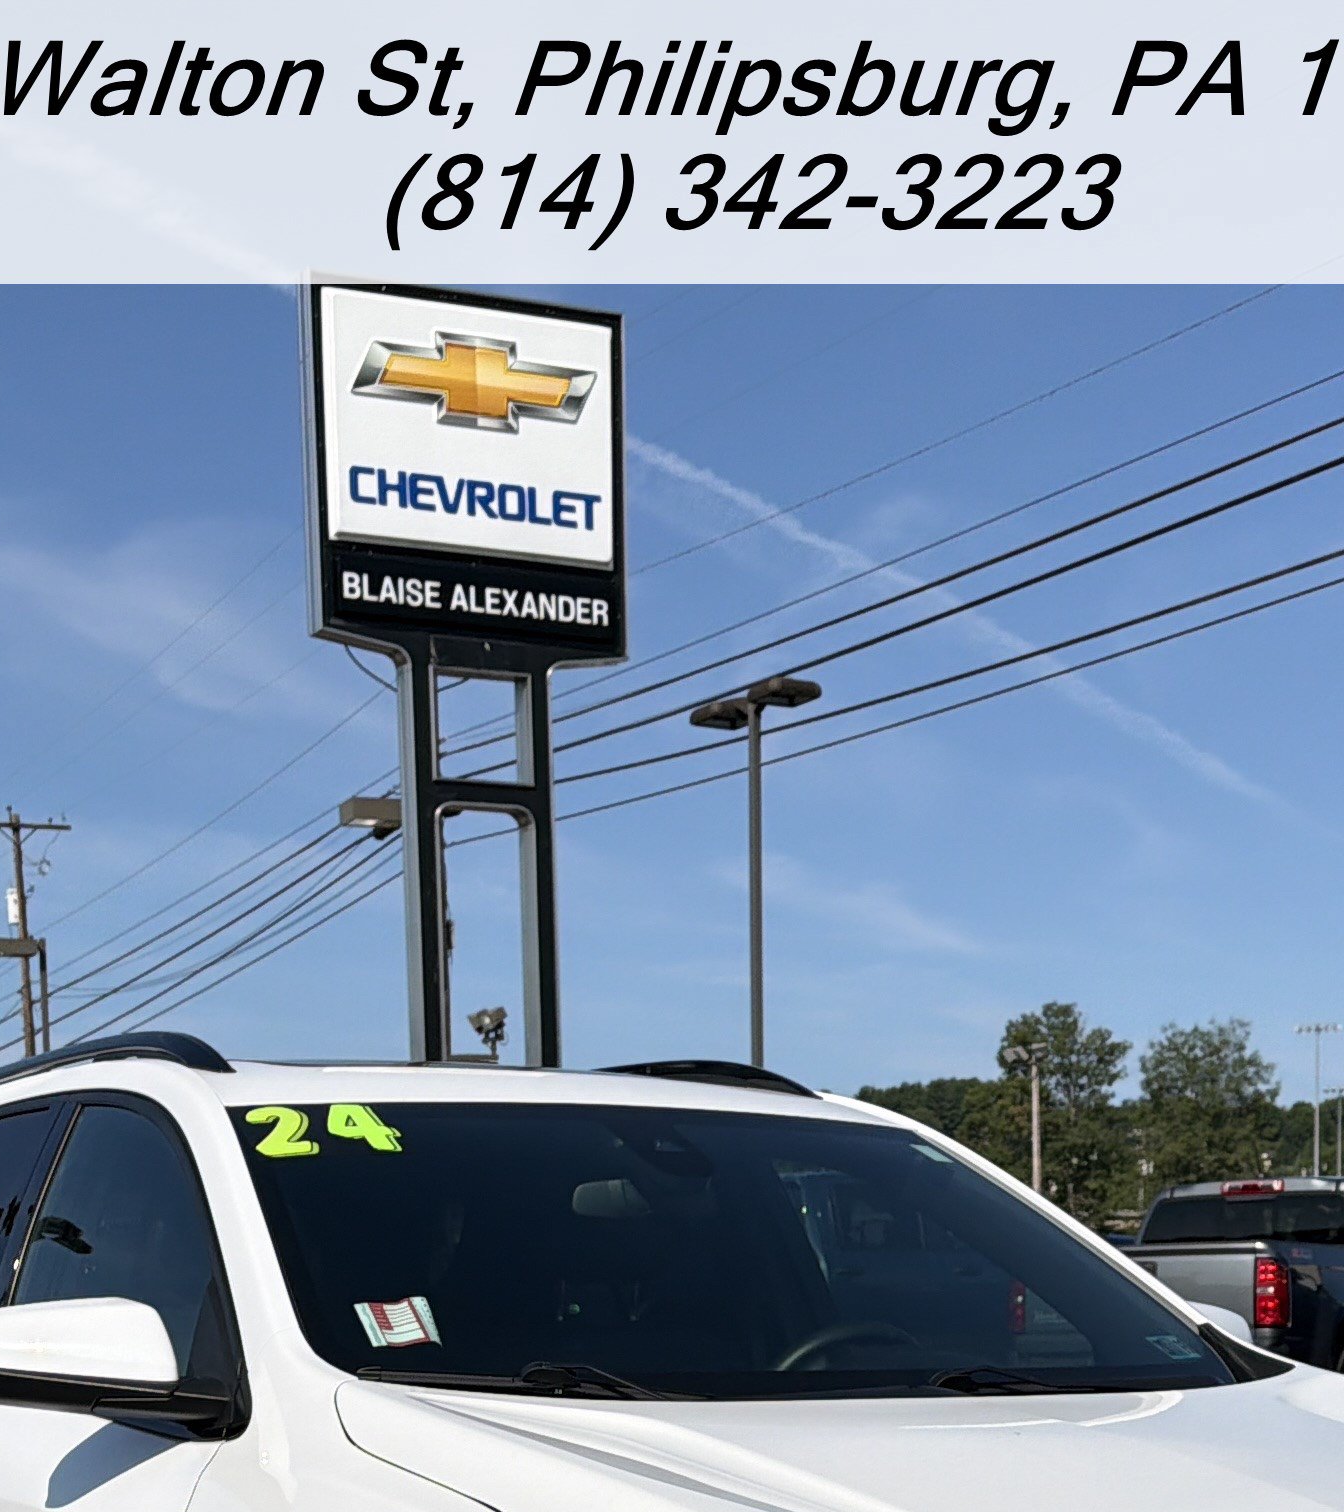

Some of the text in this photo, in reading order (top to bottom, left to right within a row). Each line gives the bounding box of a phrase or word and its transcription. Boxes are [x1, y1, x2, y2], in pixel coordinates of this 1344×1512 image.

[349, 465, 602, 531] CHEVROLET
[342, 571, 610, 627] BLAISE ALEXANDER
[245, 1102, 403, 1158] 24
